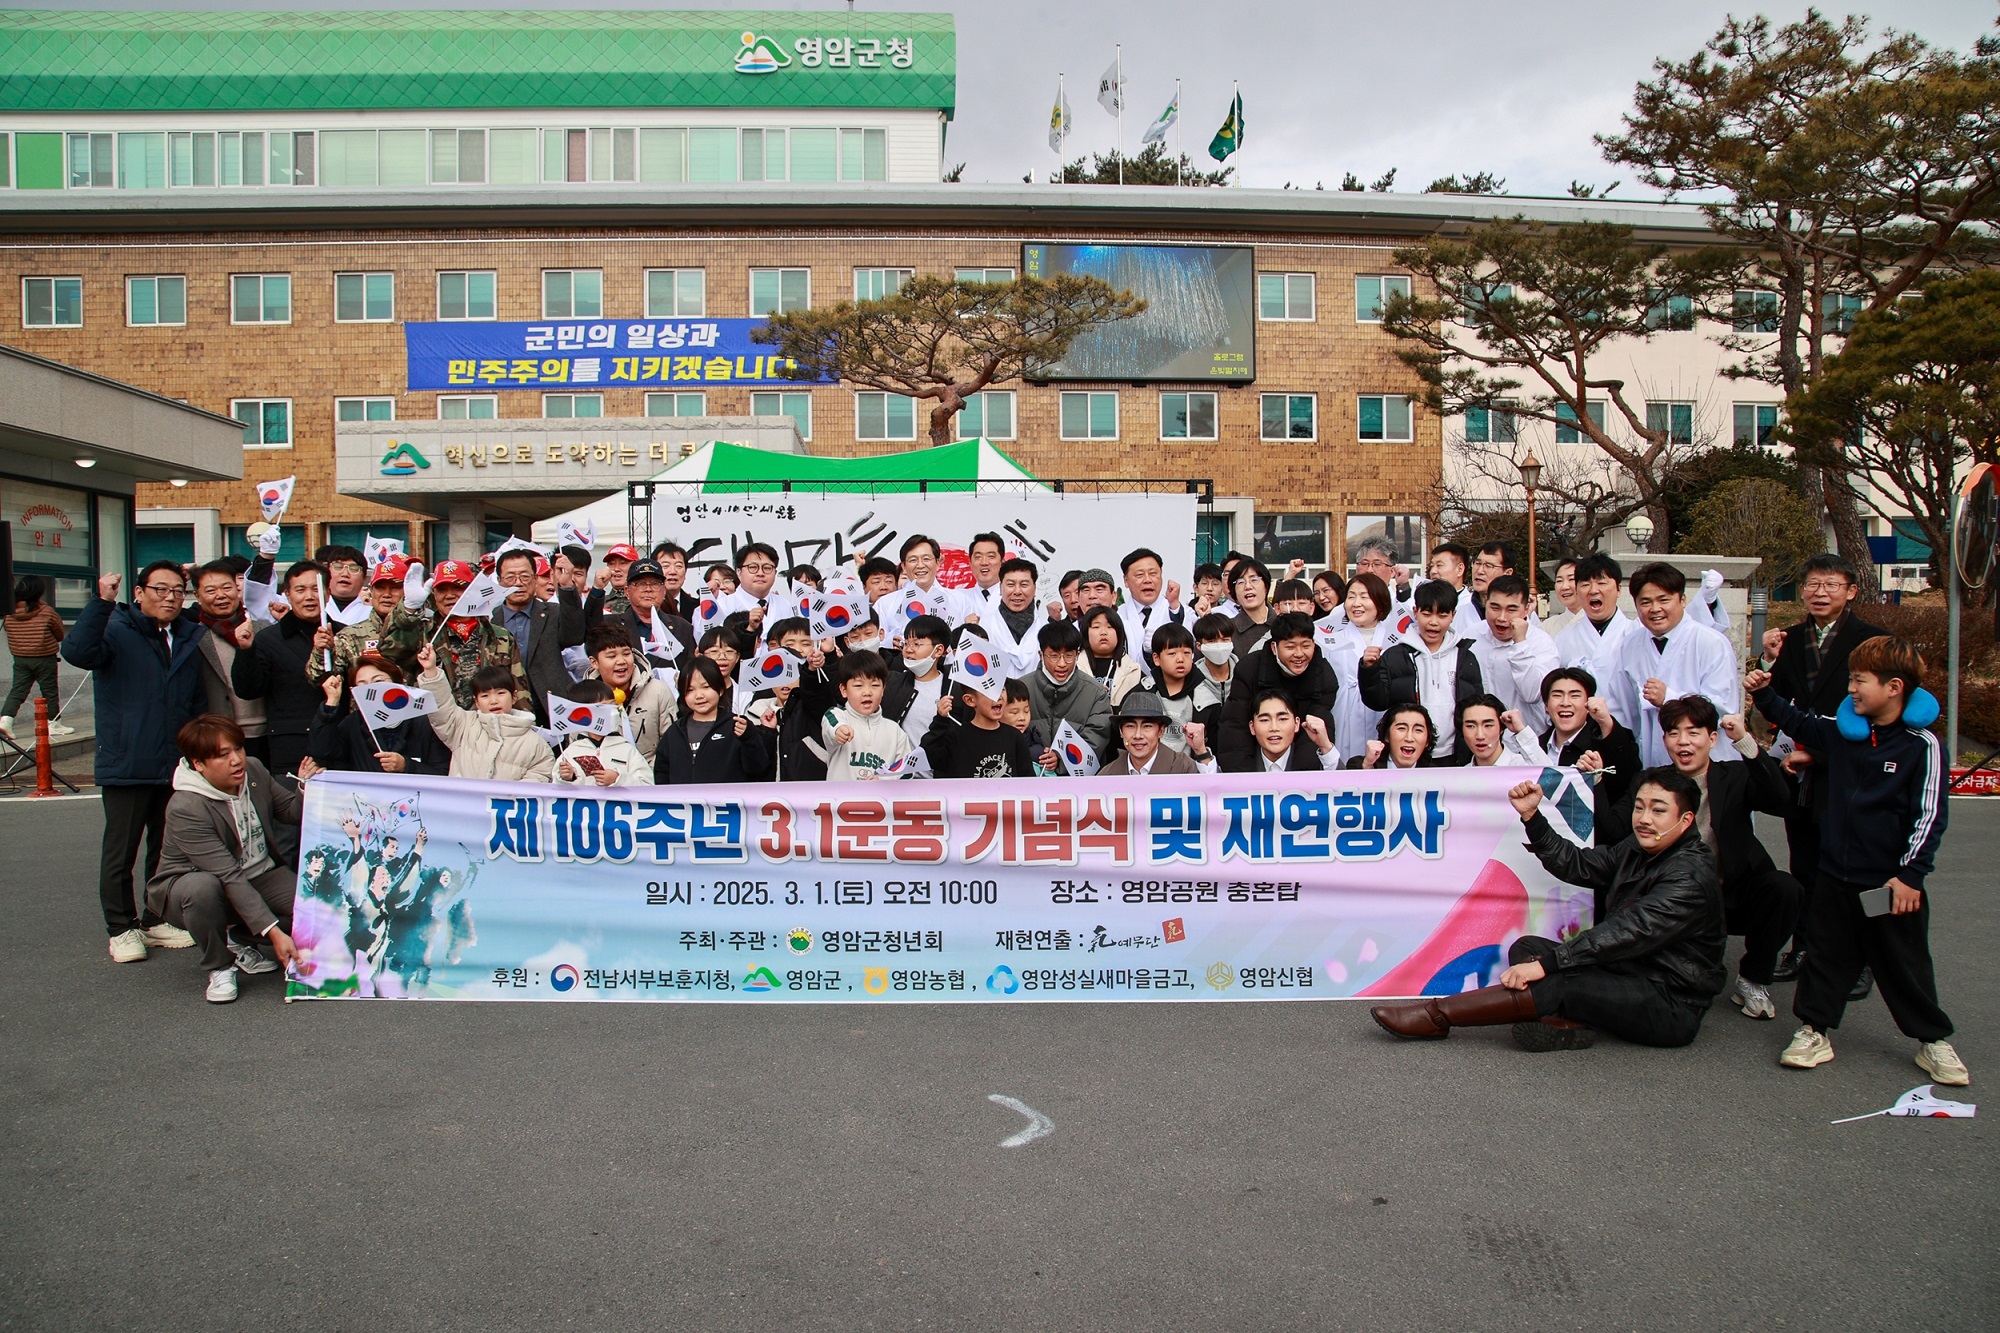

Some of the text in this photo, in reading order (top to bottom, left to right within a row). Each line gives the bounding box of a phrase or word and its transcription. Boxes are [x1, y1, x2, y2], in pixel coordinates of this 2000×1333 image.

[795, 37, 913, 68] 영암군청
[525, 323, 720, 351] 군민의 일상과
[448, 355, 798, 384] 민주주의를 지키겠습니다
[445, 443, 534, 468] 혁신으로
[545, 441, 639, 467] 도약하는
[647, 441, 668, 465] 더
[21, 504, 73, 531] INFORMATION
[980, 754, 1002, 767] SPACE
[758, 800, 944, 861] 3.1운동
[963, 797, 1130, 863] 기념식
[1149, 796, 1202, 860] 및
[1221, 790, 1446, 860] 재연행사
[645, 881, 692, 905] 일시
[713, 880, 774, 905] 2025.
[785, 880, 804, 905] 3.
[883, 880, 931, 905] 오전
[939, 880, 998, 905] 10:00
[1050, 880, 1099, 904] 장소
[1121, 880, 1219, 903] 영암공원
[1226, 881, 1302, 902] 충혼탑
[821, 930, 943, 953] 영암군청년회
[995, 929, 1072, 951] 재현연출
[491, 967, 528, 989] 후원
[583, 968, 736, 992] 전남서부보훈지청,
[1021, 968, 1196, 990] 영암성실새마을금고,
[1239, 966, 1314, 988] 영암신협
